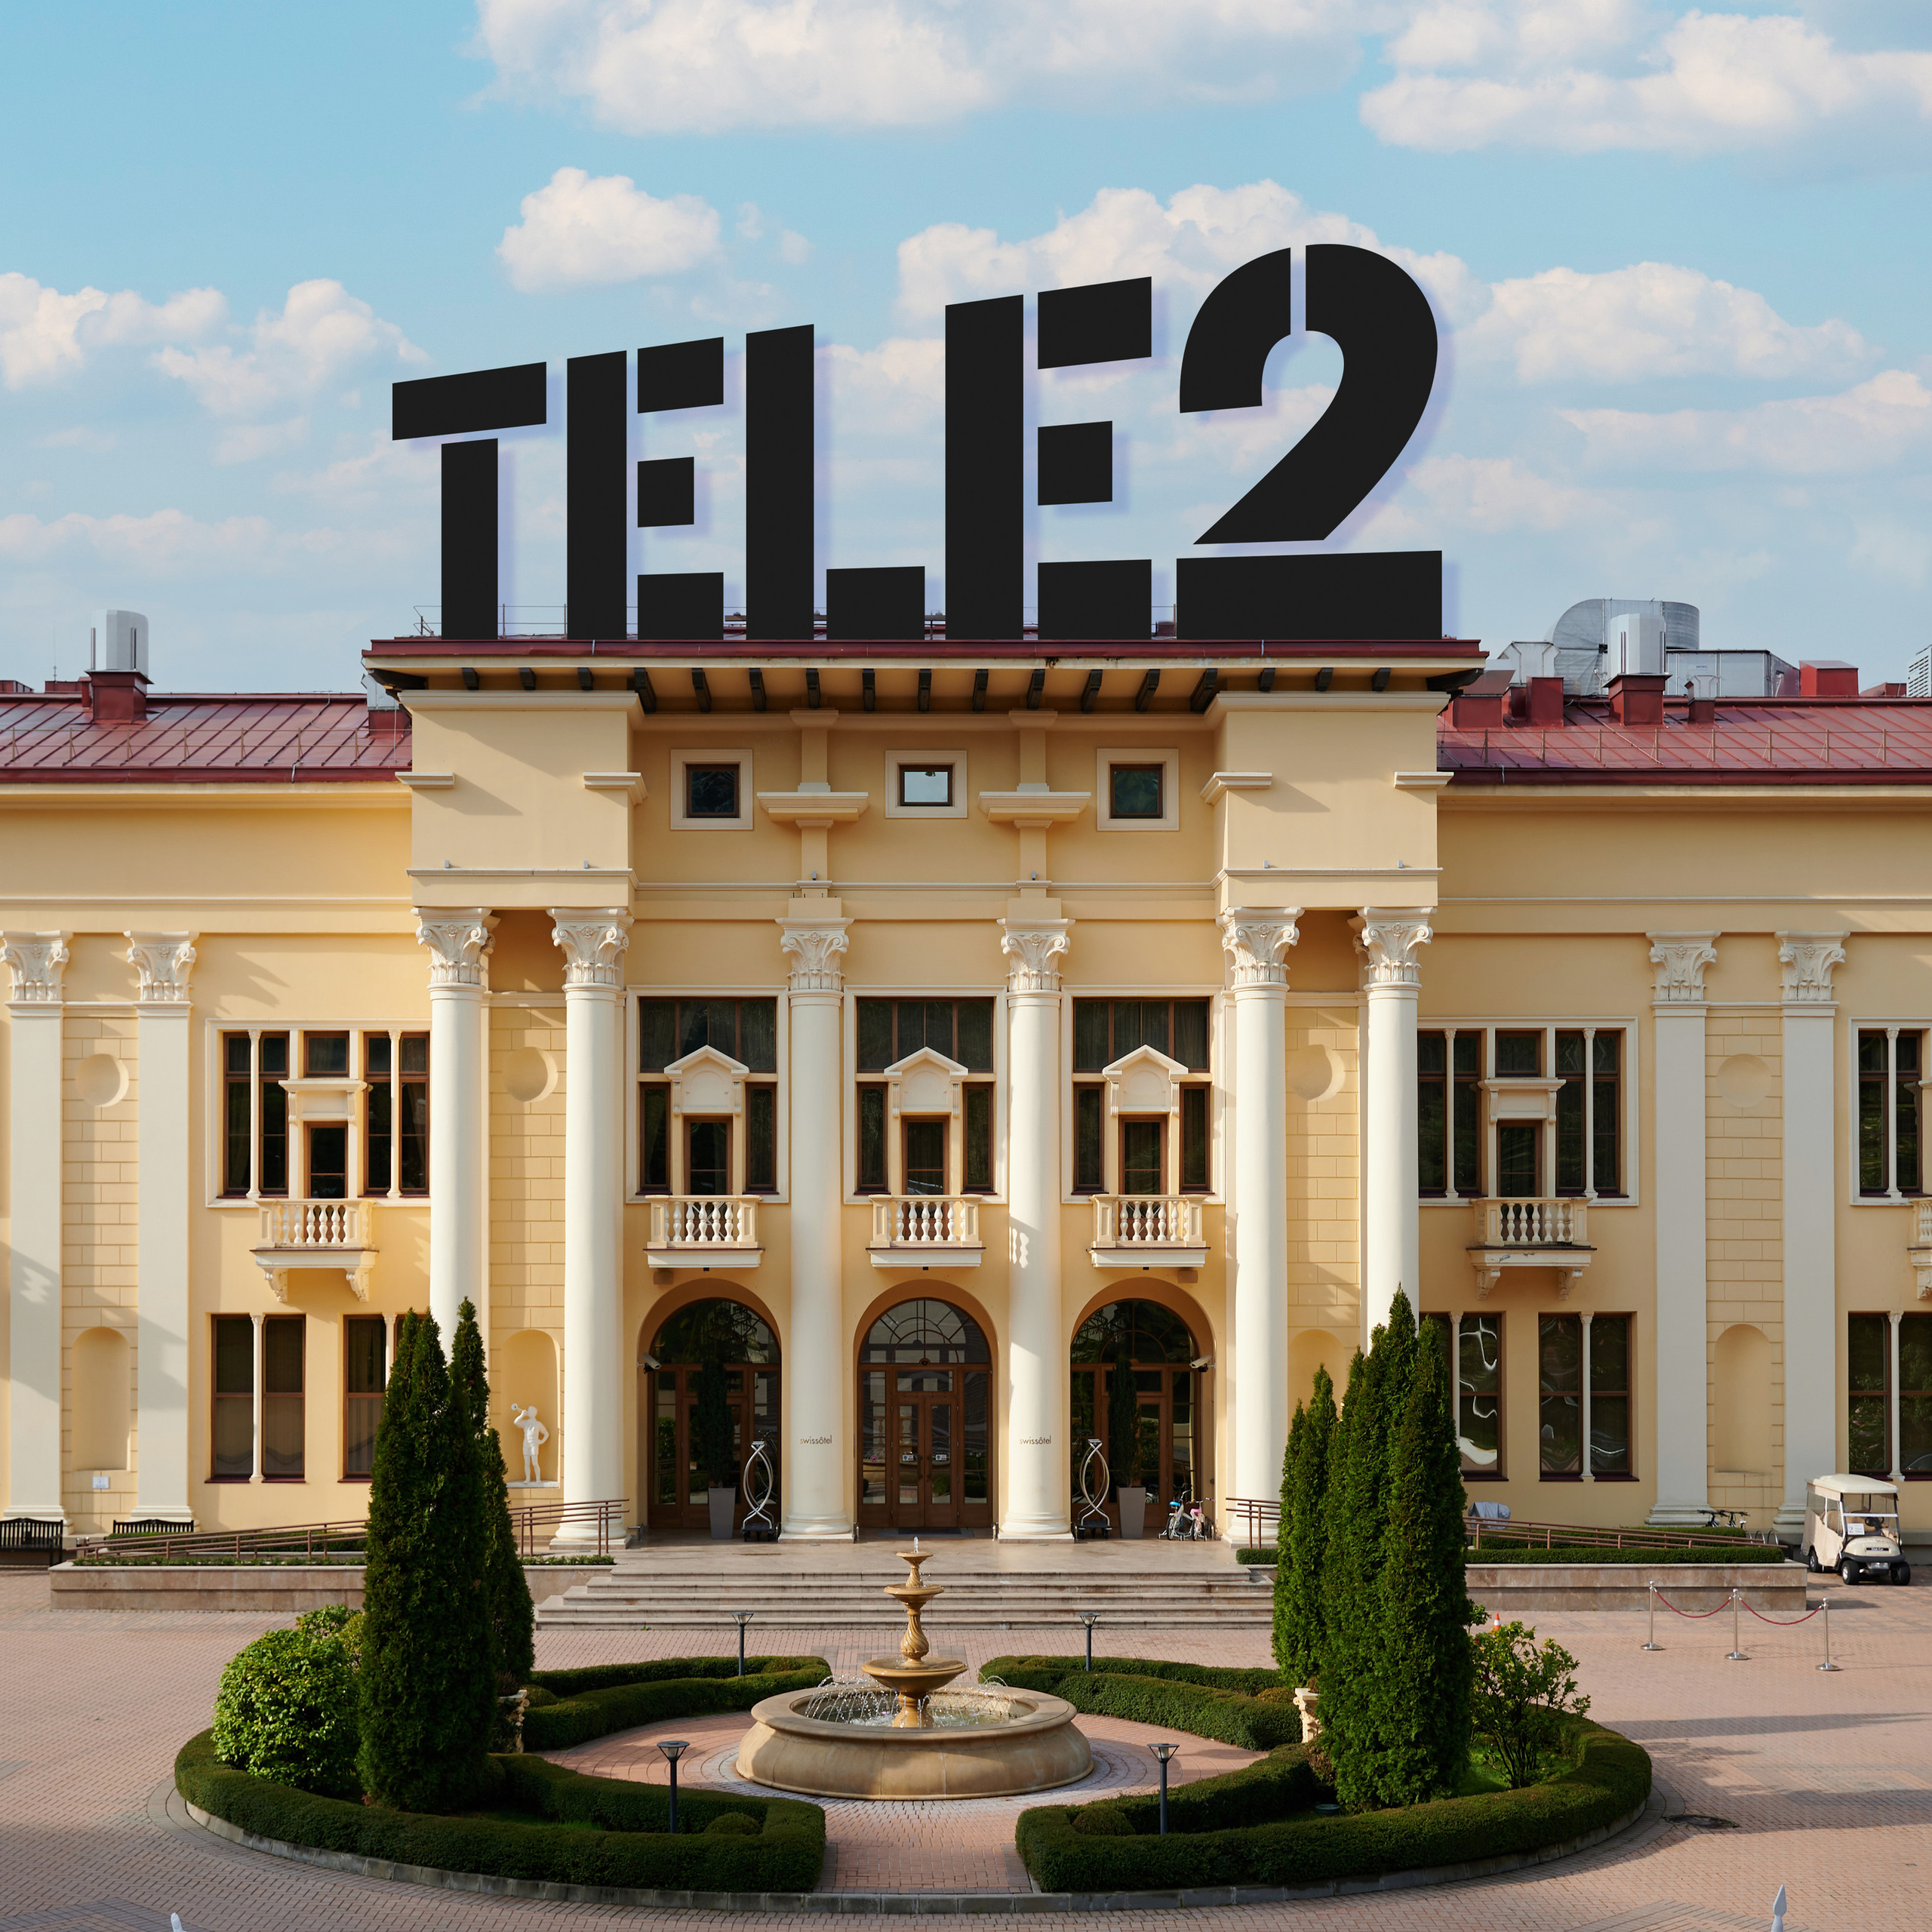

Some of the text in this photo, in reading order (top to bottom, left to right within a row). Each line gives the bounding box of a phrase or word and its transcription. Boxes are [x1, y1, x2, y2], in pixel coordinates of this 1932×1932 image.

[392, 245, 1442, 640] TELE2
[800, 1435, 832, 1444] swissôtel
[1019, 1435, 1051, 1444] swissôtel
